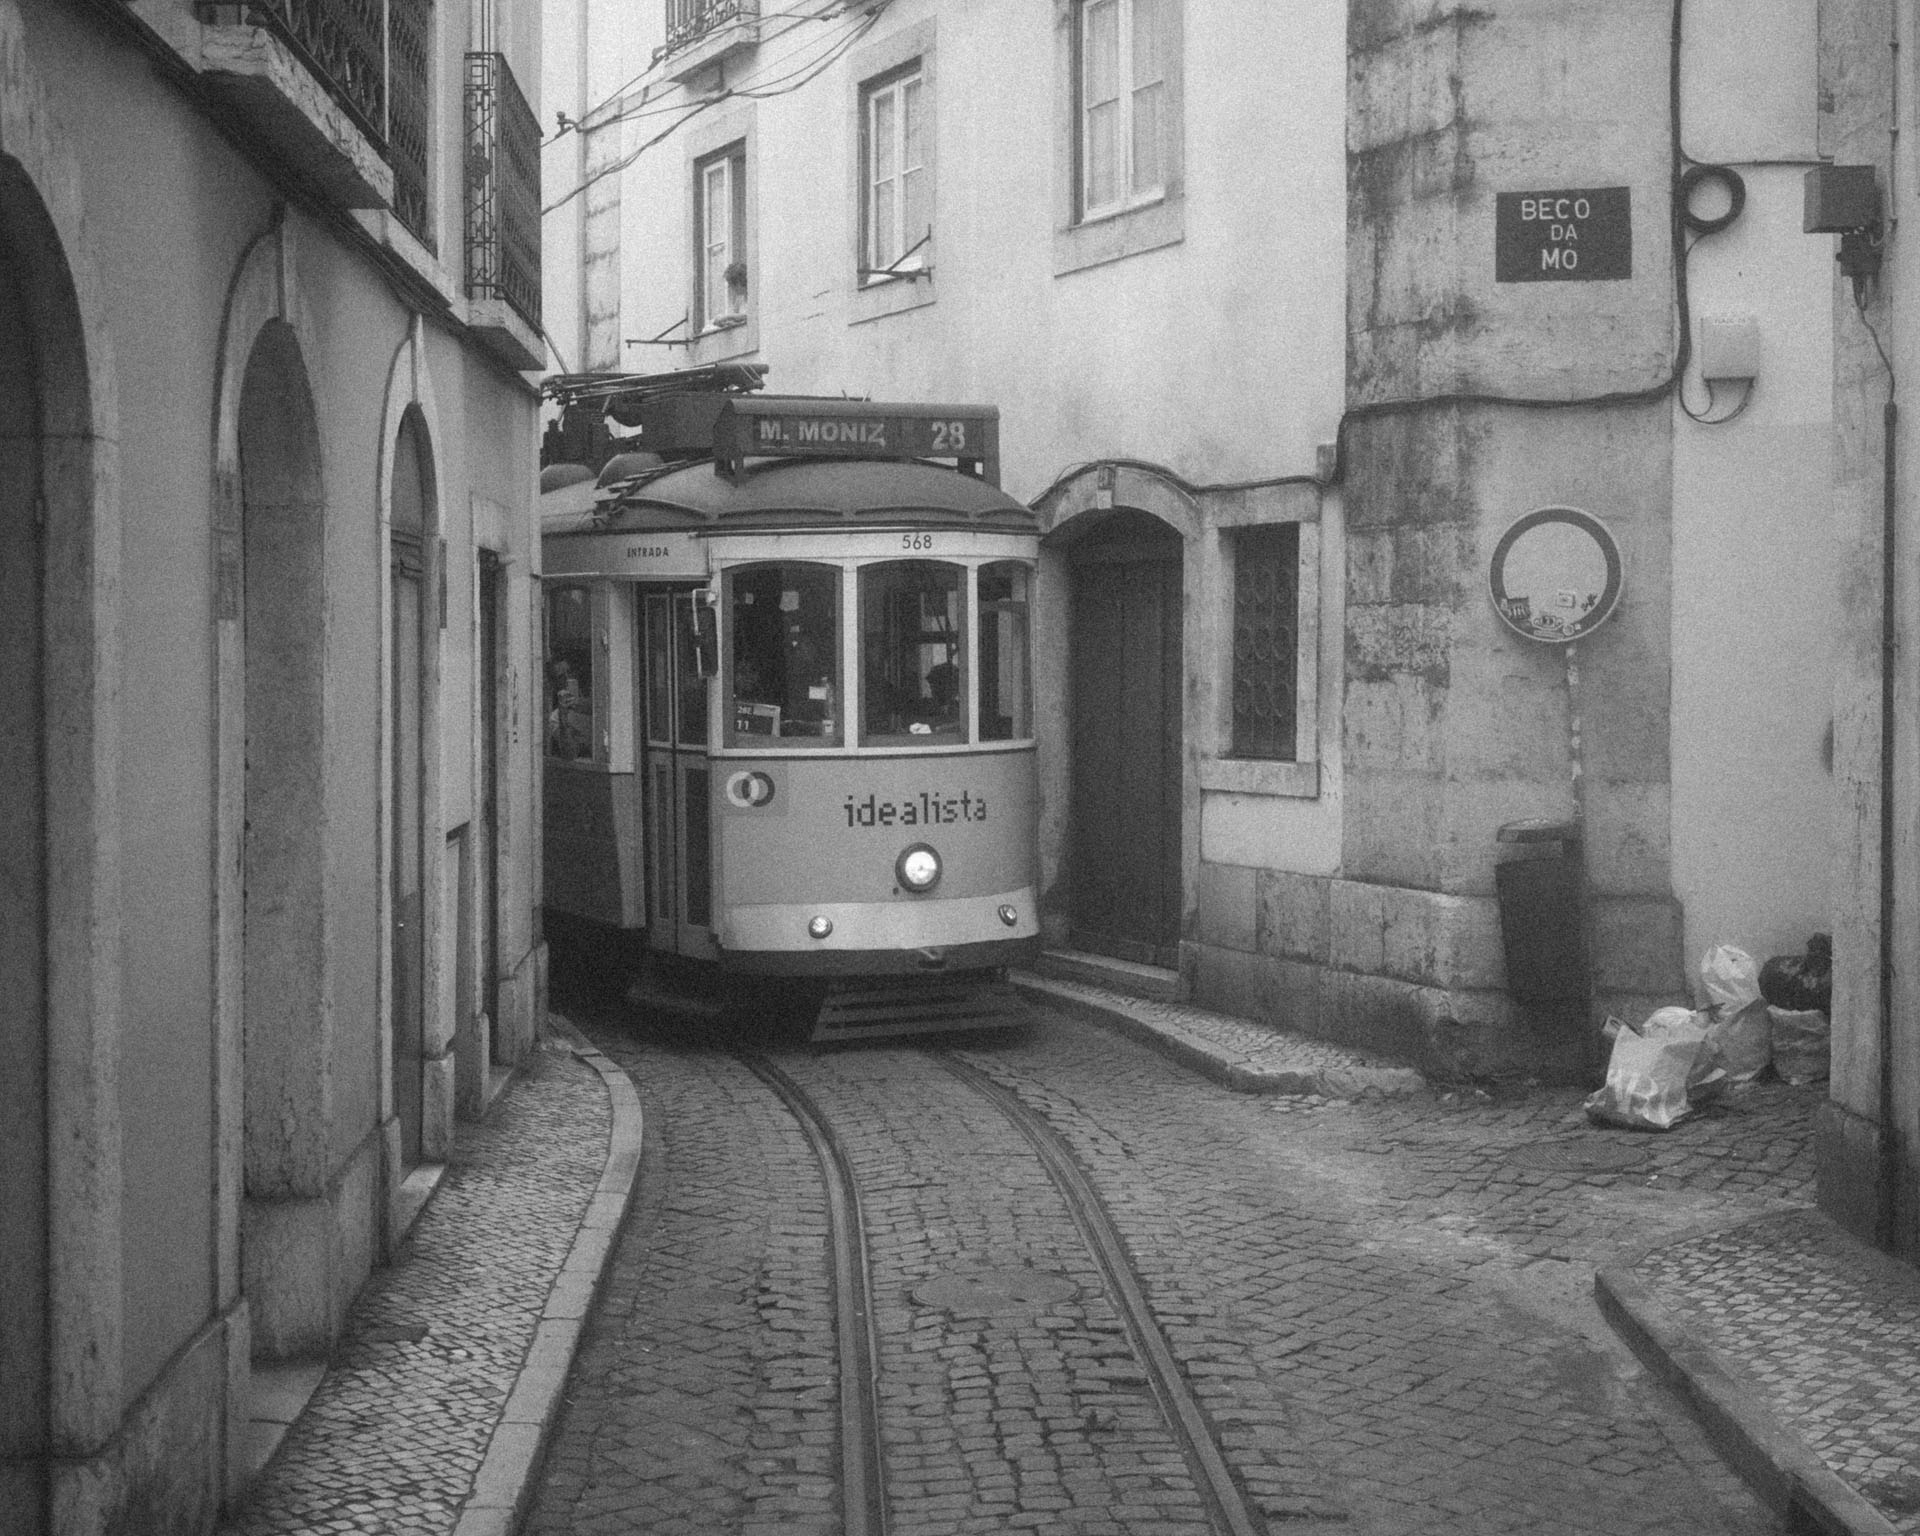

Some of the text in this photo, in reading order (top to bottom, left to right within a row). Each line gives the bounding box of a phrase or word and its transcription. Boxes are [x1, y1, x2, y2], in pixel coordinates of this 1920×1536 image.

[1521, 198, 1590, 220] BECO
[1551, 223, 1578, 241] DA
[760, 421, 886, 448] M. MONIZ
[930, 421, 966, 450] 28
[626, 546, 670, 558] ENTRADA
[901, 534, 933, 550] 568
[843, 790, 987, 828] idealista
